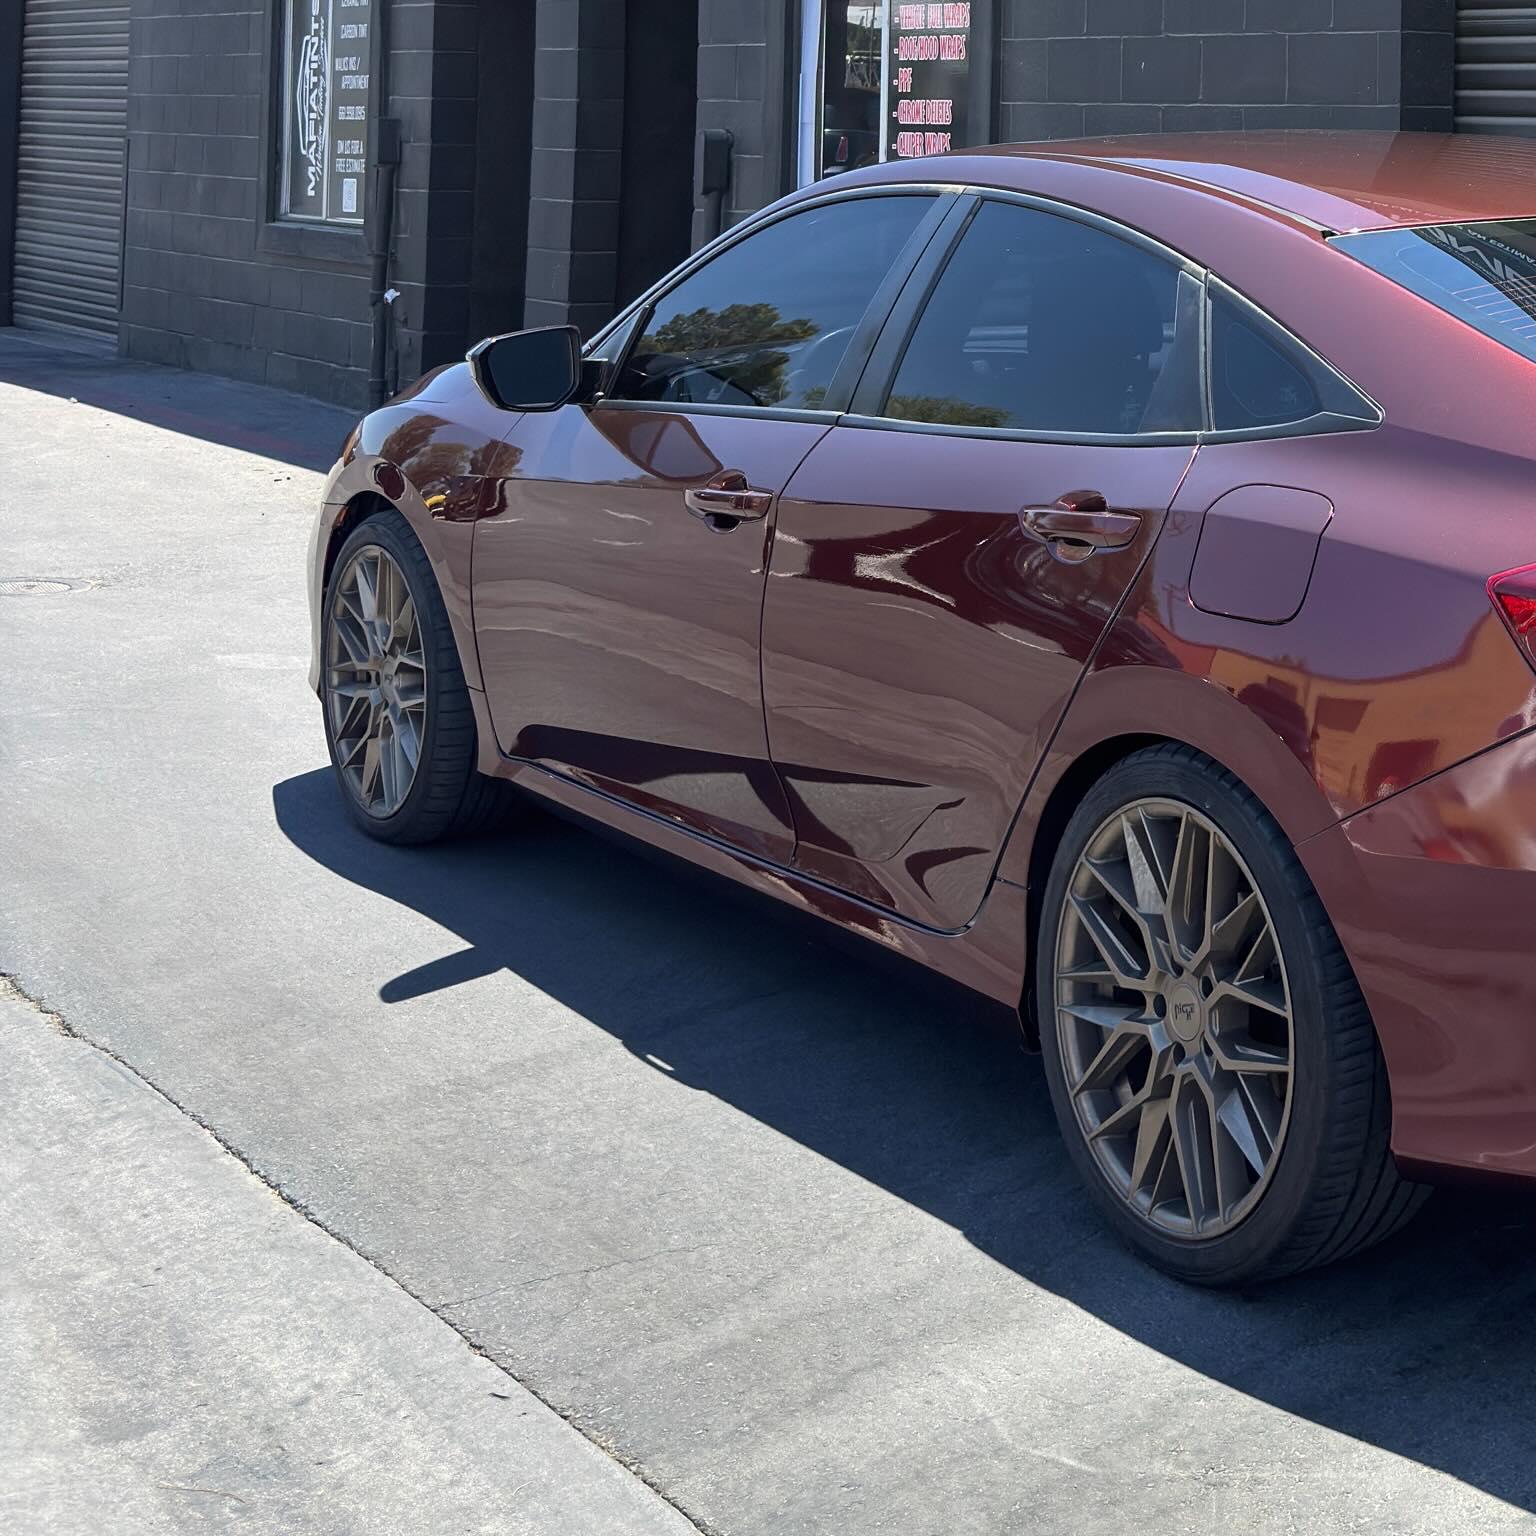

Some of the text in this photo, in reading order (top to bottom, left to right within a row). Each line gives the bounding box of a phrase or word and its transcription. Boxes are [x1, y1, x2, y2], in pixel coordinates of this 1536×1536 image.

[900, 2, 970, 29] VEHICLE FULL WRAPS
[940, 34, 966, 60] WRAPS
[898, 100, 952, 124] CHROME DELETES
[897, 132, 951, 157] CALIPER WRAPS
